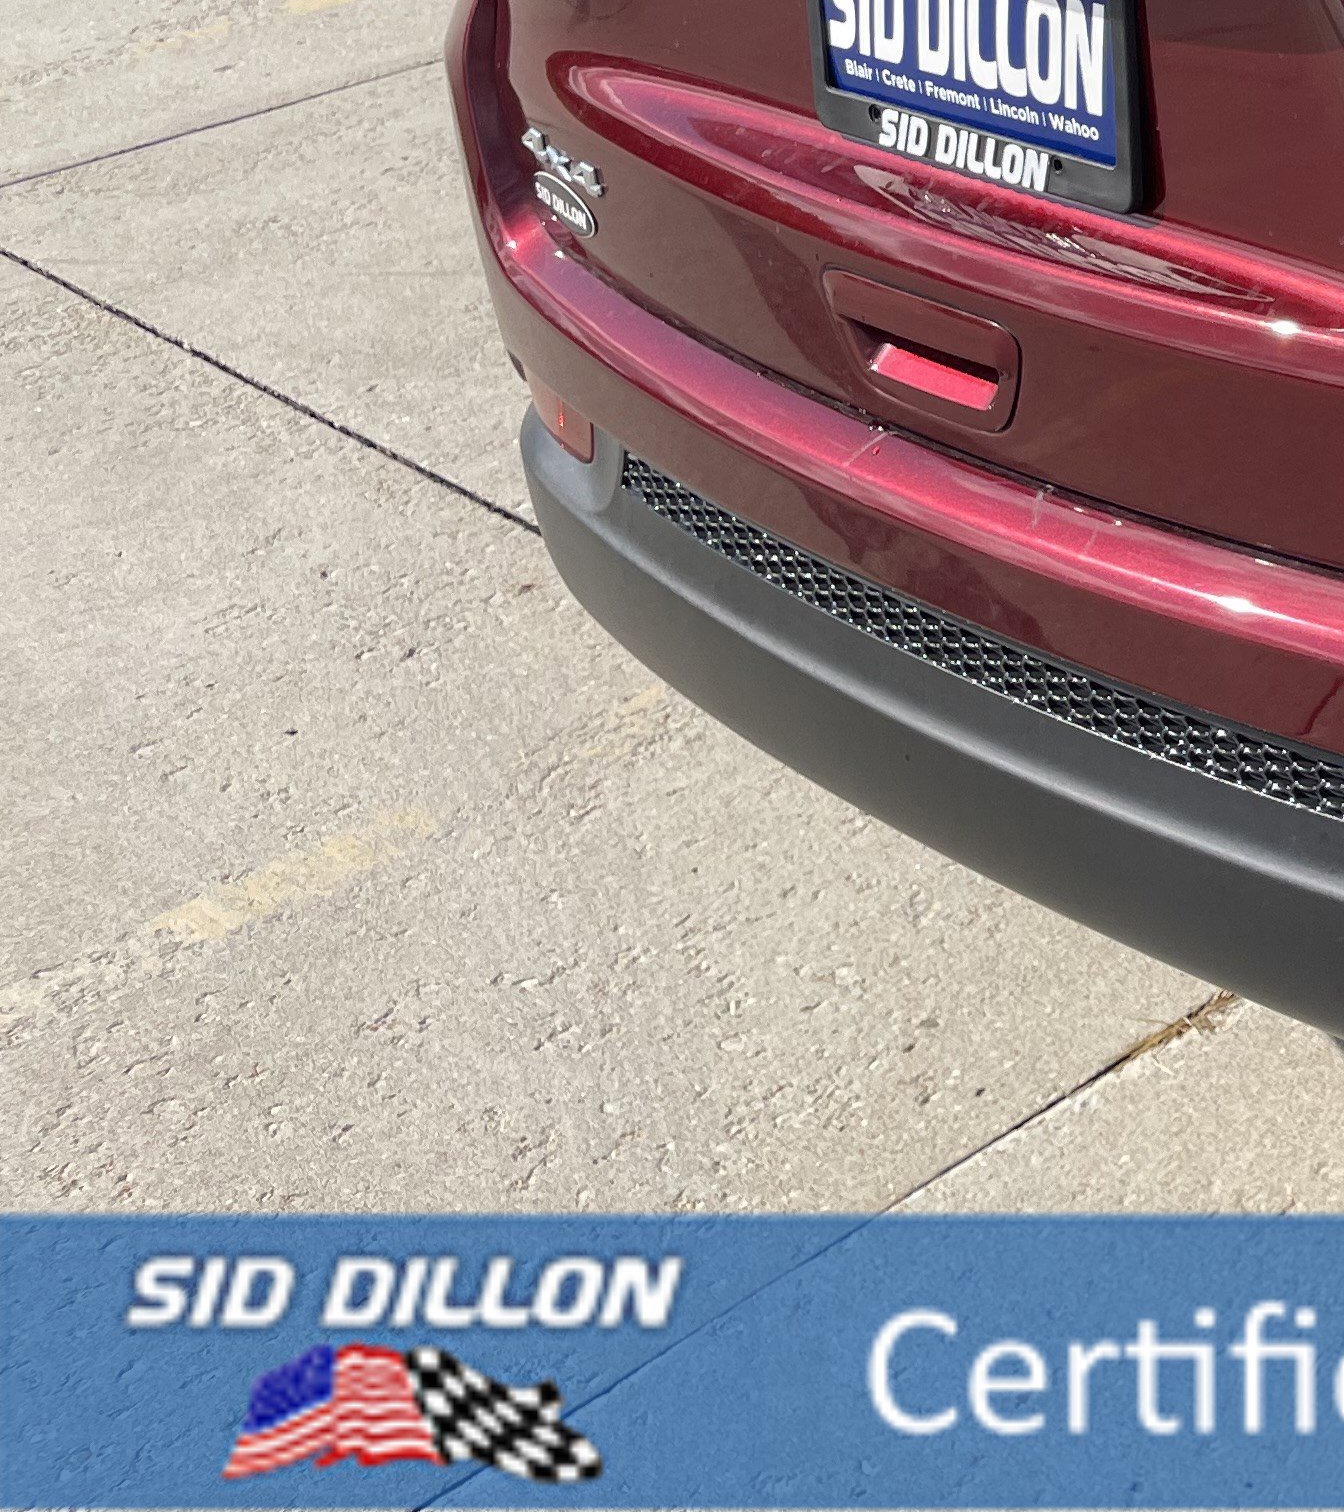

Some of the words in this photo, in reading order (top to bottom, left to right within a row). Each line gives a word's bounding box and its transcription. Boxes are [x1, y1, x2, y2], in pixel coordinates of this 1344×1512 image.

[844, 58, 873, 81] Blair
[881, 68, 916, 94] Crete
[925, 80, 981, 111] Fremont
[989, 97, 1040, 125] Lincoln
[1048, 114, 1100, 142] Wahoo
[878, 109, 929, 156] SID
[934, 133, 1049, 192] DILLON
[552, 193, 587, 230] DILLON
